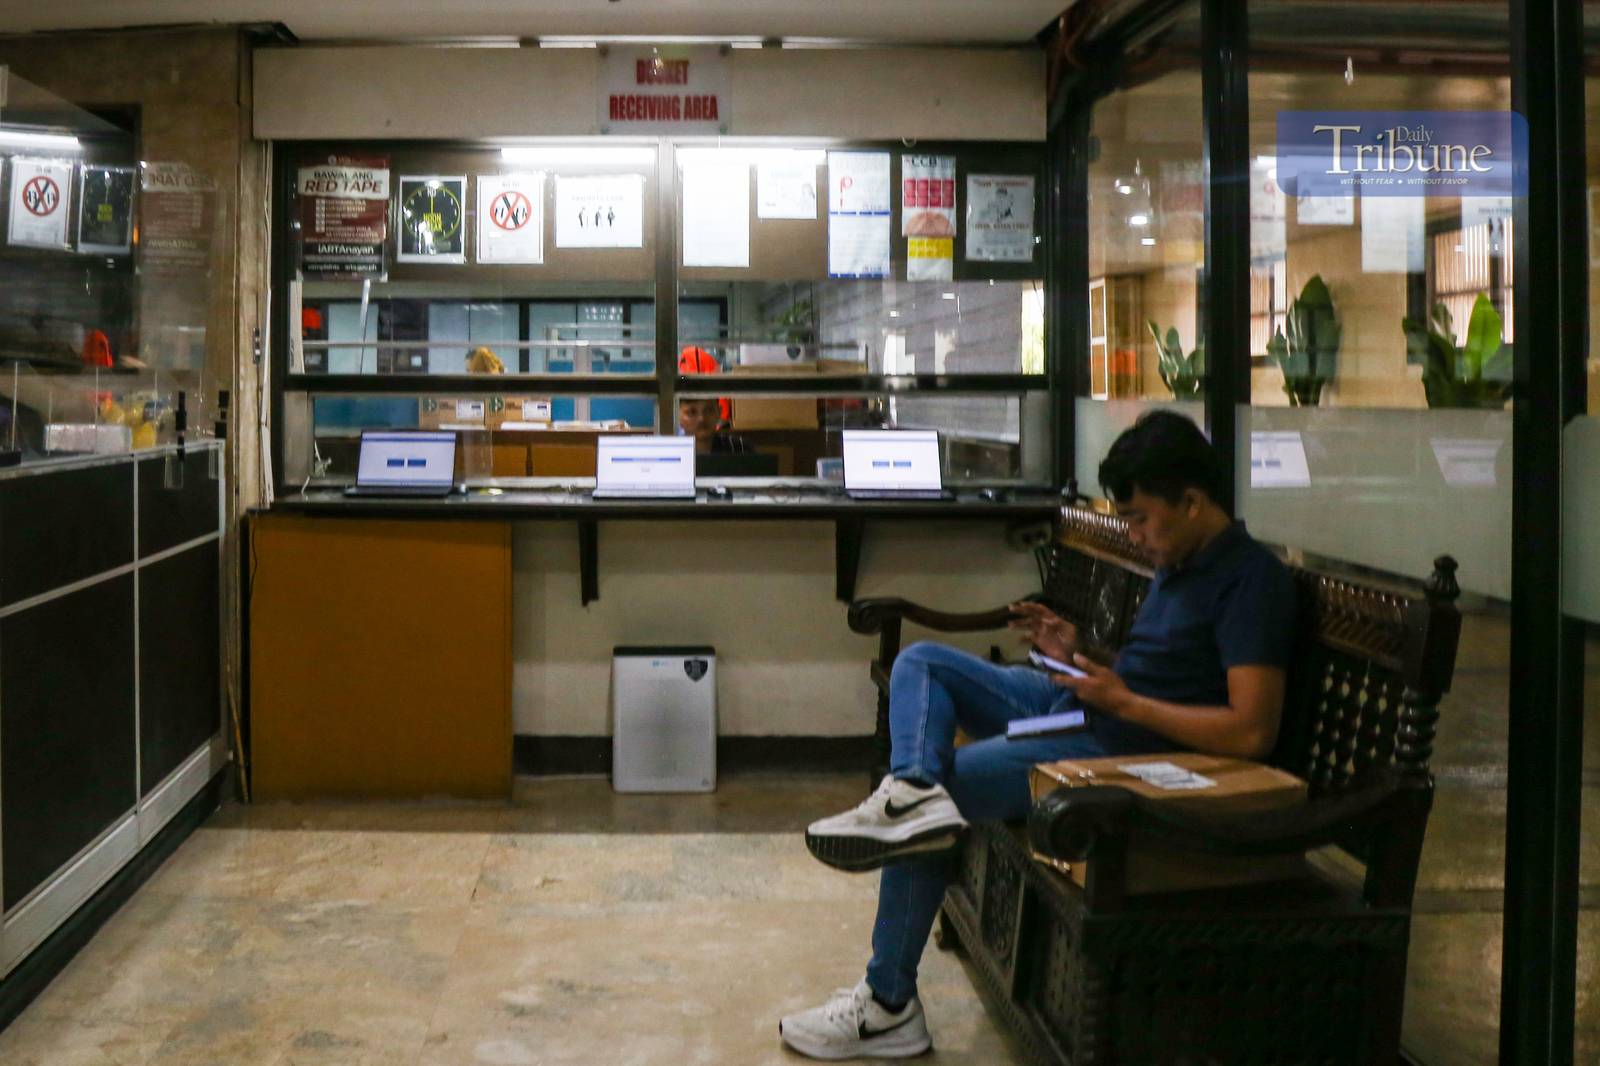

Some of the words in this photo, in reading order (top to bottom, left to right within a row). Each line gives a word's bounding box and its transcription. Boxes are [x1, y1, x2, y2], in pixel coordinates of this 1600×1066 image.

[609, 94, 681, 120] RECEIVING
[684, 94, 719, 120] AREA
[304, 180, 338, 193] RED
[343, 180, 384, 194] TAPE
